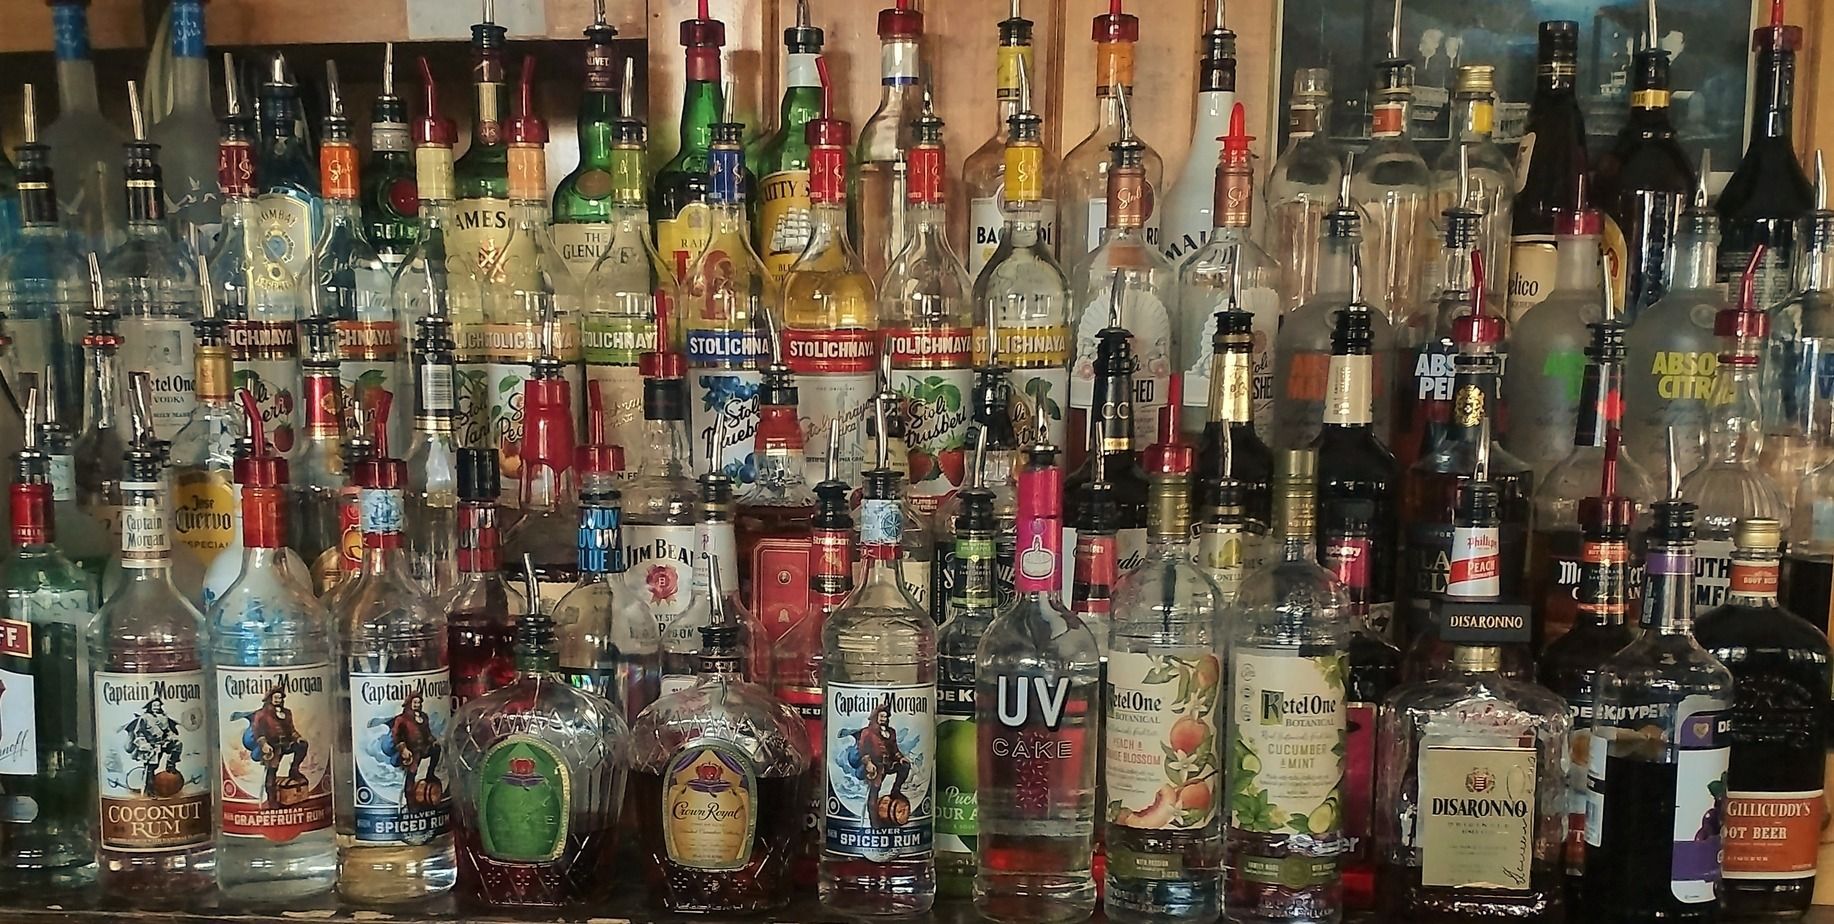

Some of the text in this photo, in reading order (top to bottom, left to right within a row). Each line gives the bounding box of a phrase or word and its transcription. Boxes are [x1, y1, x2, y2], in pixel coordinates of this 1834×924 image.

[562, 243, 604, 260] GLENL
[789, 340, 875, 358] STOLICHNAYA
[975, 334, 1067, 354] STLICHNAYA
[150, 375, 172, 392] etel
[153, 395, 185, 404] VODKA
[127, 514, 163, 532] Captain
[175, 506, 233, 534] Cuervo
[127, 532, 165, 550] Morgan
[624, 545, 652, 571] JIM
[1467, 559, 1496, 576] PEACH
[1450, 615, 1523, 629] DISARONNO
[103, 679, 200, 706] Captain Morgan
[225, 673, 323, 700] Captain Morgan
[361, 681, 411, 706] Captain
[834, 691, 879, 717] Captain
[880, 691, 928, 717] Morgan
[997, 674, 1071, 730] UV
[1113, 690, 1162, 712] etel One
[1262, 690, 1336, 721] Ketel One
[1285, 718, 1335, 728] BOTANICAL
[992, 737, 1073, 759] CAKE
[1268, 743, 1328, 756] CUCUMBER
[1288, 758, 1315, 769] MINT
[108, 802, 203, 824] COCONUT
[672, 801, 744, 822] Crown Royal
[1432, 797, 1528, 819] DISARONNO
[1727, 800, 1811, 818] GILLICUDDY'S
[131, 820, 182, 838] RUM
[234, 813, 304, 827] GRAPEFRUIT
[375, 818, 427, 834] SPICED
[840, 832, 921, 848] SPICED RUM
[1752, 826, 1787, 841] BEER
